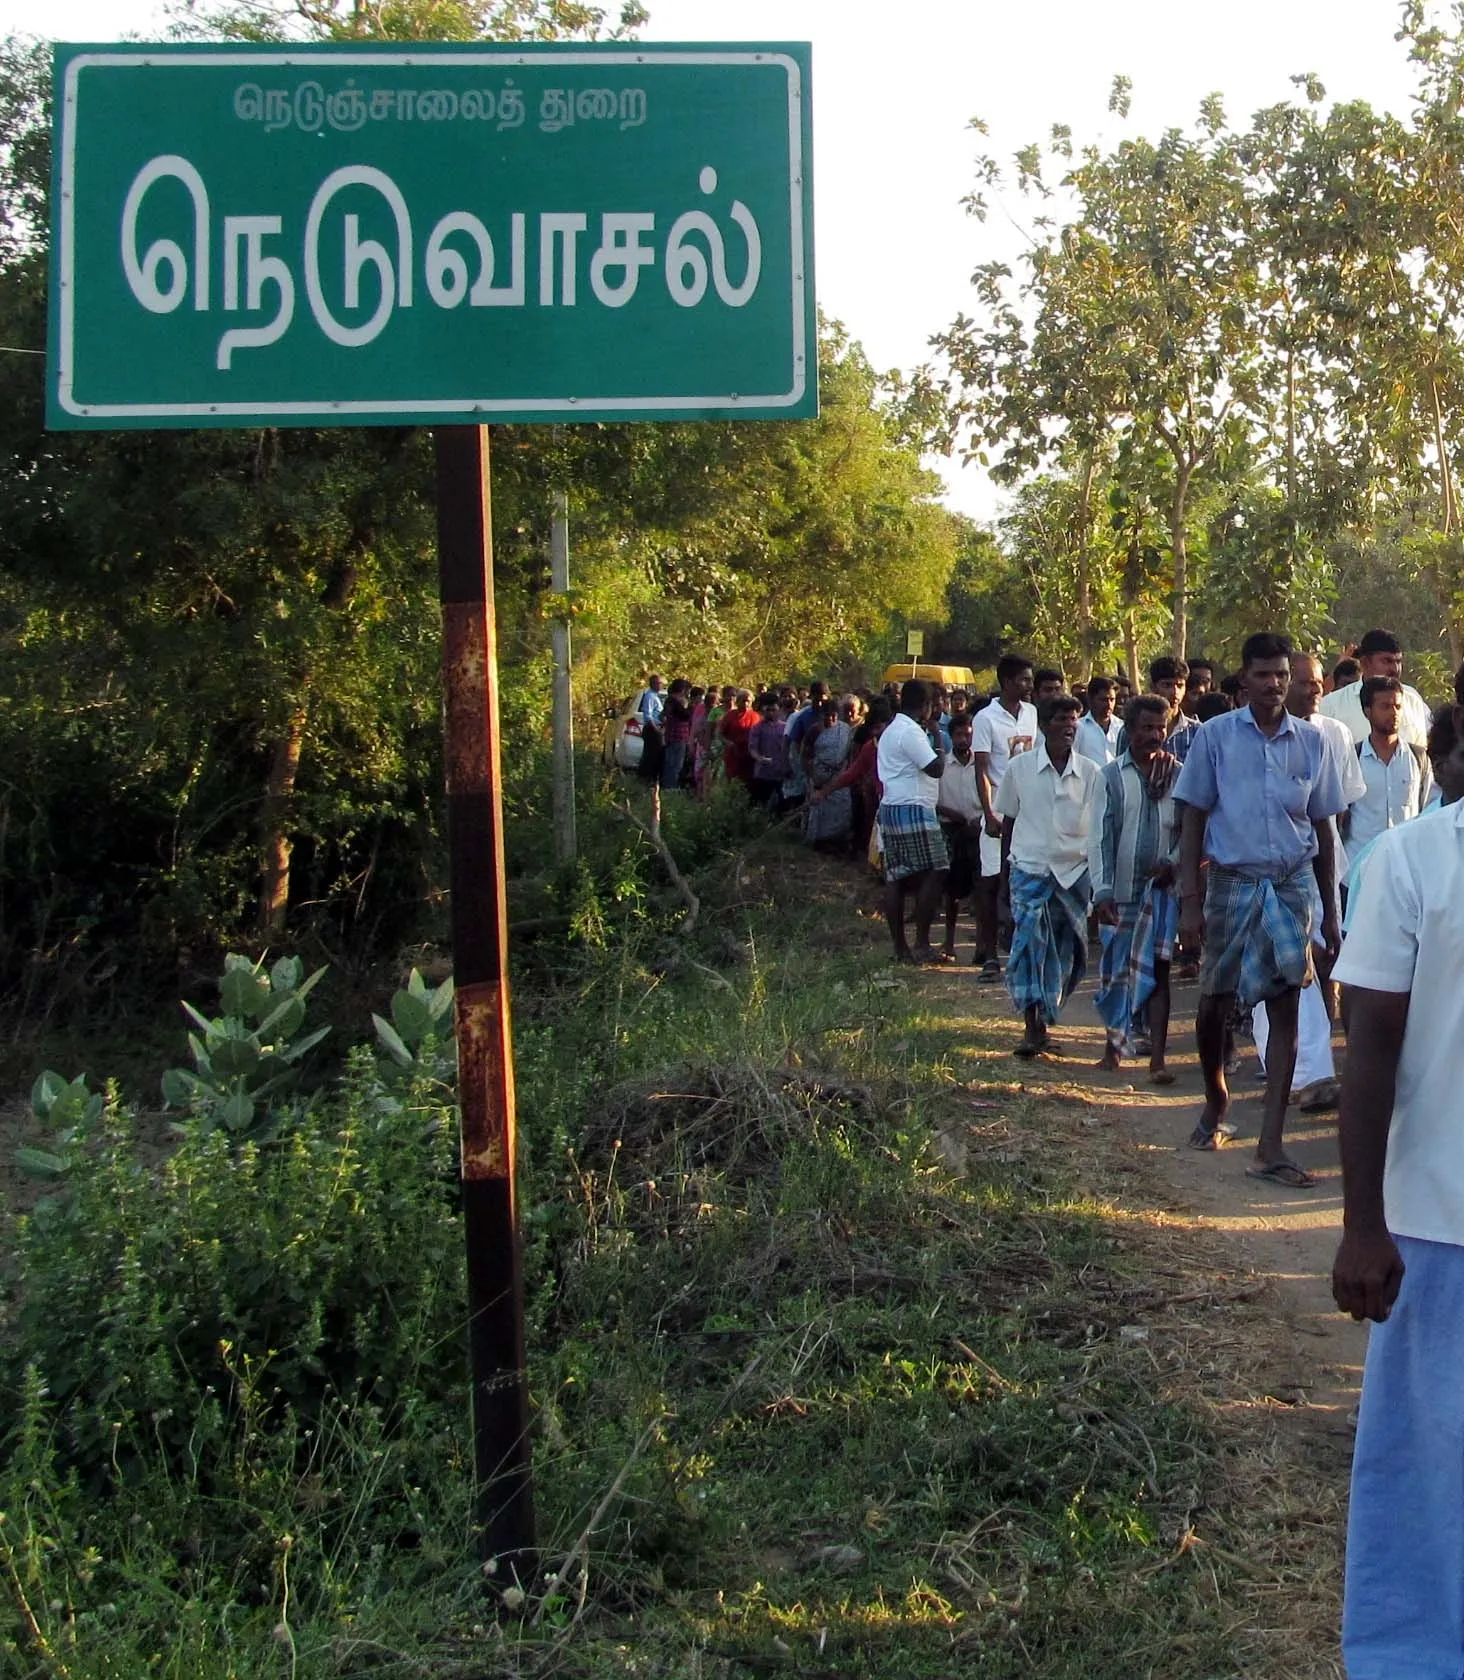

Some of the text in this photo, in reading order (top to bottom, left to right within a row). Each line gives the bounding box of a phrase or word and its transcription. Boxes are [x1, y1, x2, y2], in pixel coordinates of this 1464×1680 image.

[233, 78, 647, 132] நெடுஞ்சாலைத் துறை
[121, 154, 762, 370] நெடுவாசல்
